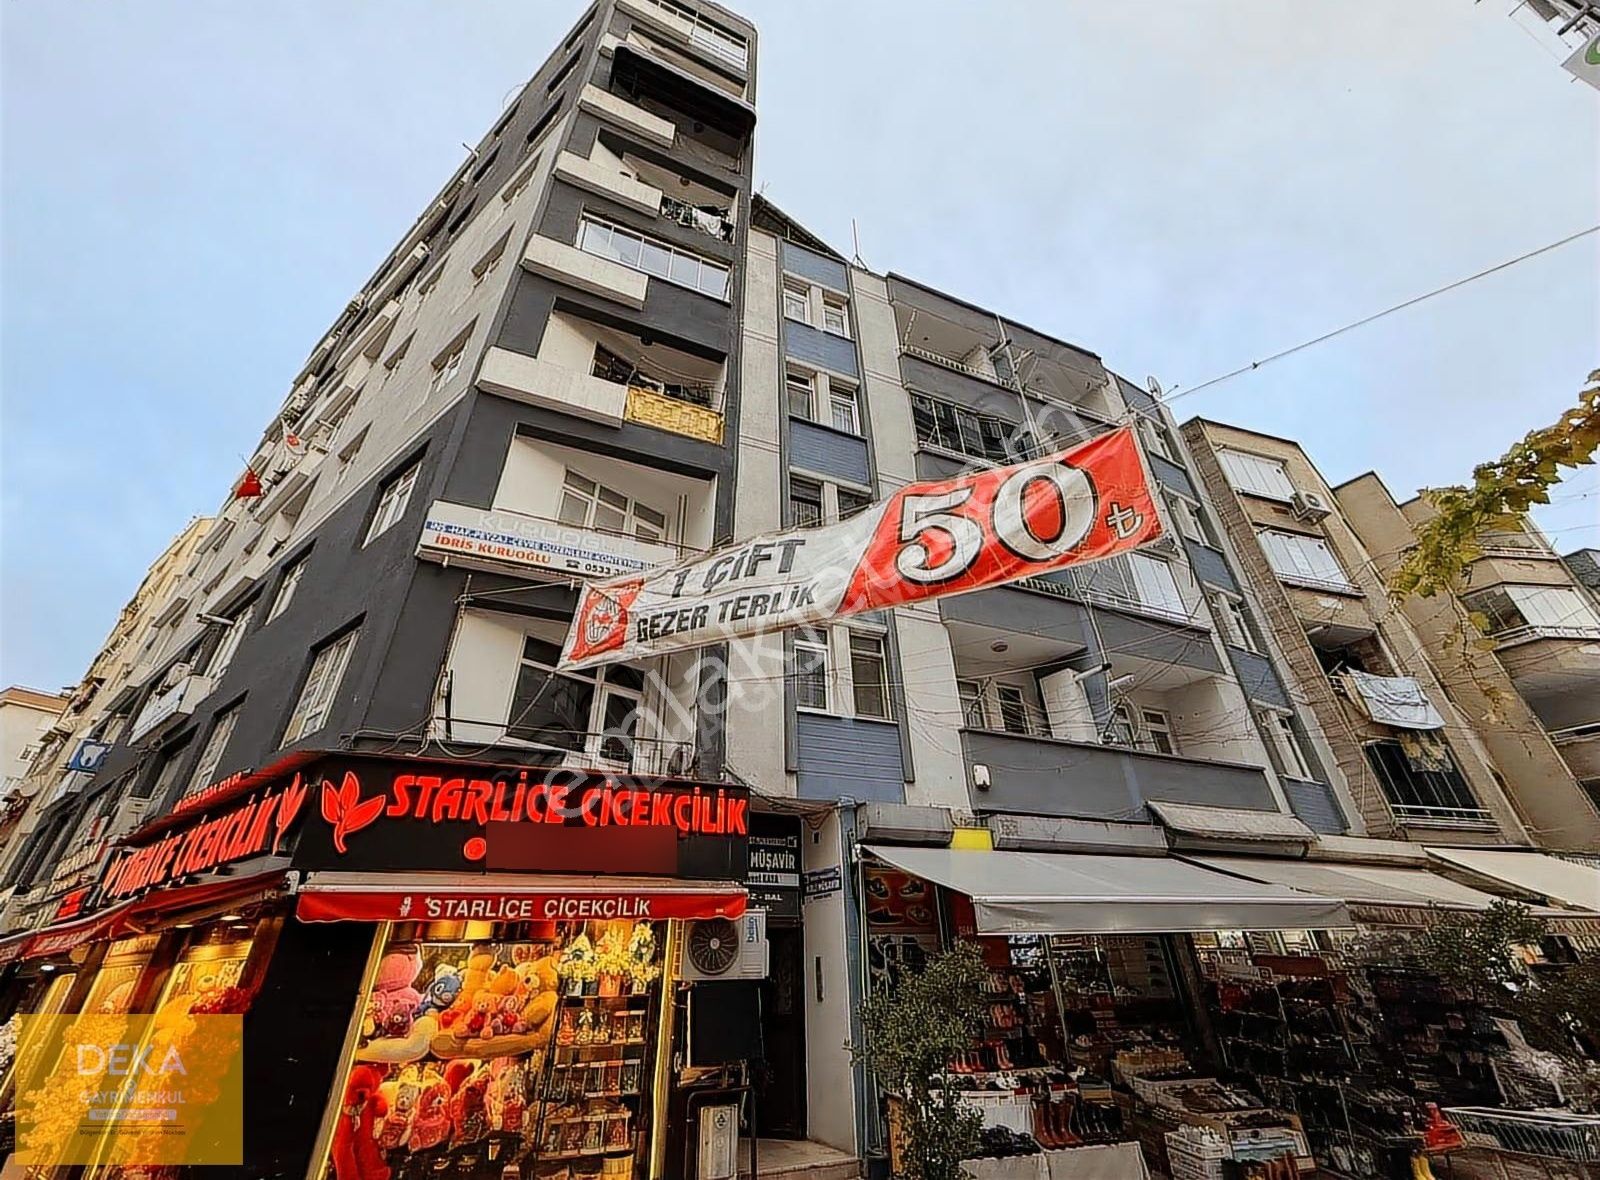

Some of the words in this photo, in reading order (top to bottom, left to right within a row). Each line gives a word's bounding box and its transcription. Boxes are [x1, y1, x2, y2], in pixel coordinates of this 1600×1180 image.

[671, 567, 691, 598] 1
[702, 538, 807, 595] ÇİFT
[896, 462, 1098, 583] 50
[434, 534, 474, 551] İDRİS
[478, 542, 552, 565] KURUOĞLU
[636, 603, 710, 643] GEZER
[717, 580, 821, 624] TERLİK
[750, 849, 796, 871] MÜŞAVİR
[544, 896, 651, 918] ÇİÇEKÇİLİK
